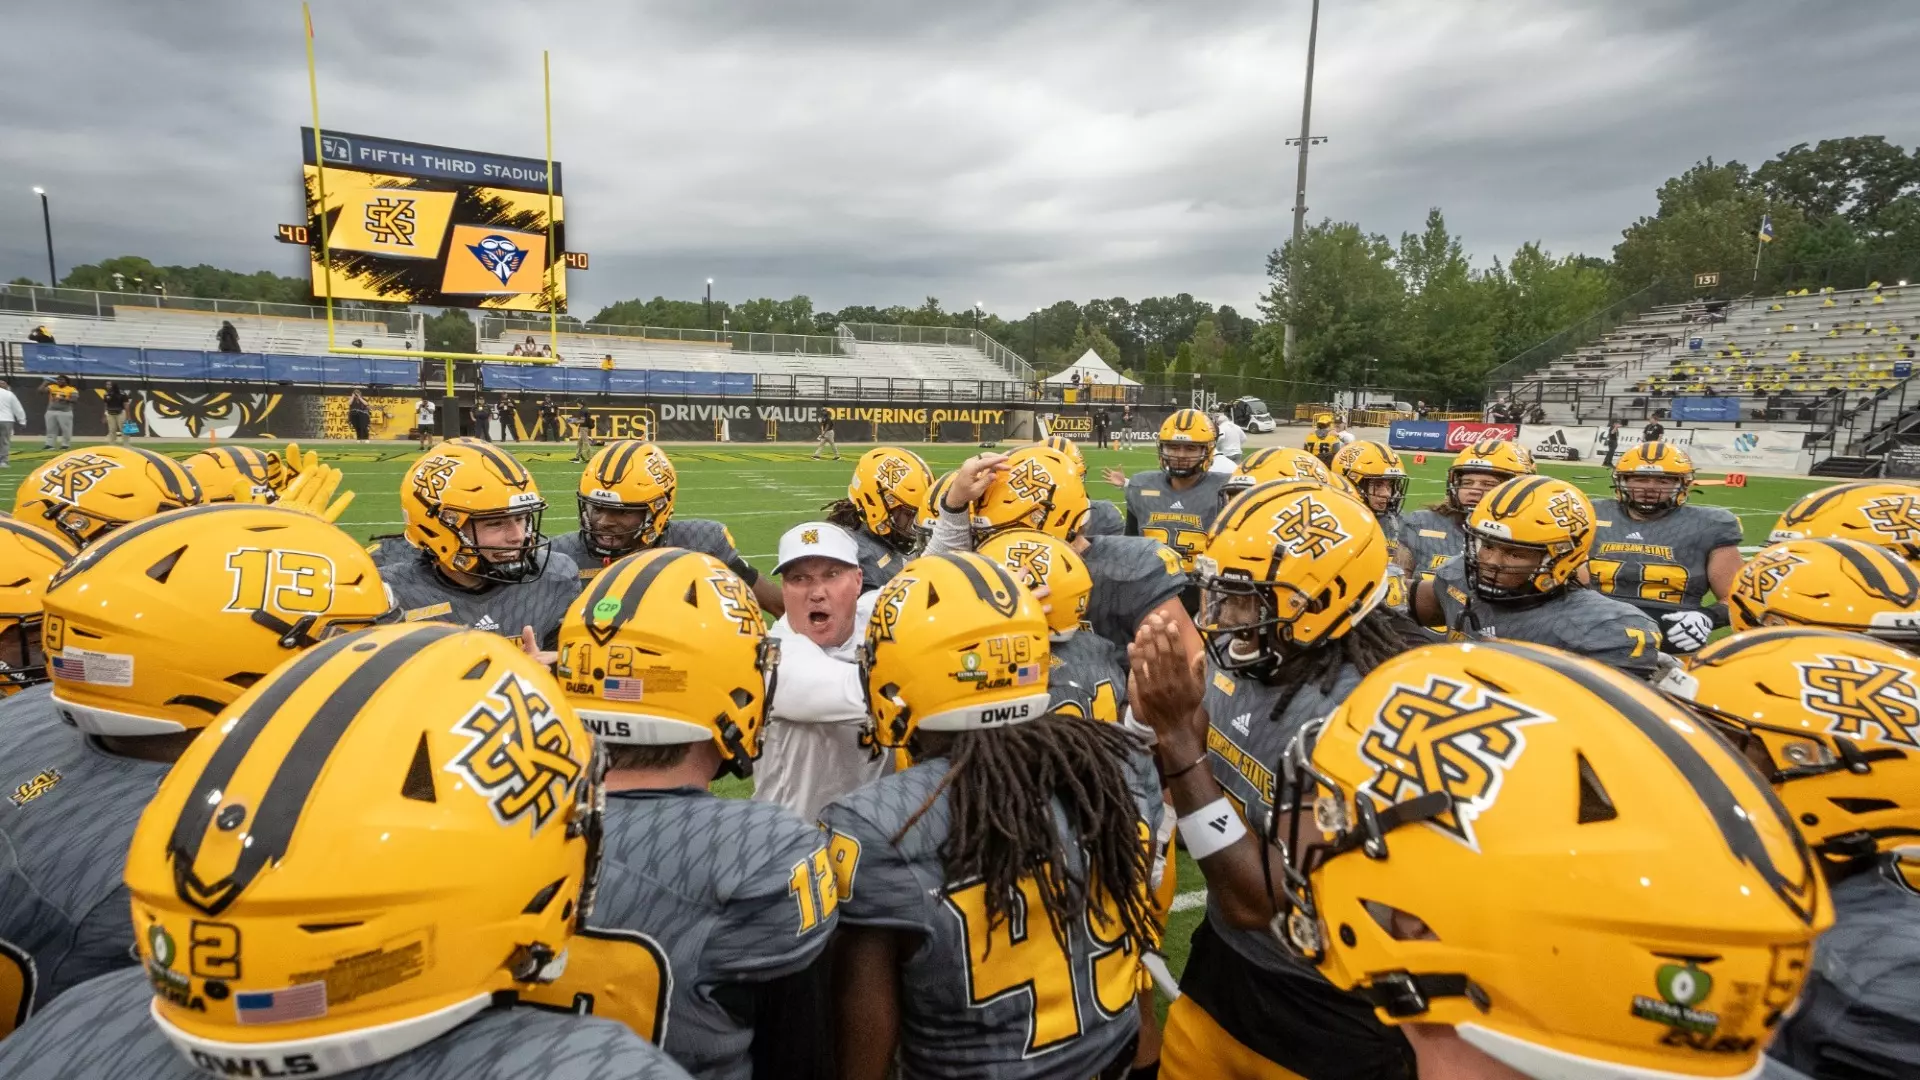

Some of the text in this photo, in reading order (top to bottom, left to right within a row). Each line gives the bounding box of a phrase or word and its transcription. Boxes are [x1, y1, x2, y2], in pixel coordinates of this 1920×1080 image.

[360, 147, 415, 166] FIFTH
[421, 154, 477, 175] THIRD
[483, 164, 550, 184] STADIUM
[279, 225, 308, 243] 40
[567, 253, 588, 270] 40
[1697, 275, 1717, 285] 131
[661, 404, 750, 422] DRIVING
[826, 407, 1005, 425] DELIVERING QUALITY.
[1045, 415, 1091, 434] VOYLES
[1537, 444, 1572, 454] adidas
[1727, 474, 1742, 485] 10
[1600, 542, 1673, 561] KENNESAW STATE
[222, 547, 336, 616] 13
[1588, 558, 1690, 604] 72
[597, 602, 619, 613] C2P
[987, 636, 1031, 665] 49
[981, 704, 1029, 724] OWLS
[583, 718, 632, 738] WLS
[788, 844, 839, 937] 12
[190, 919, 242, 981] 2
